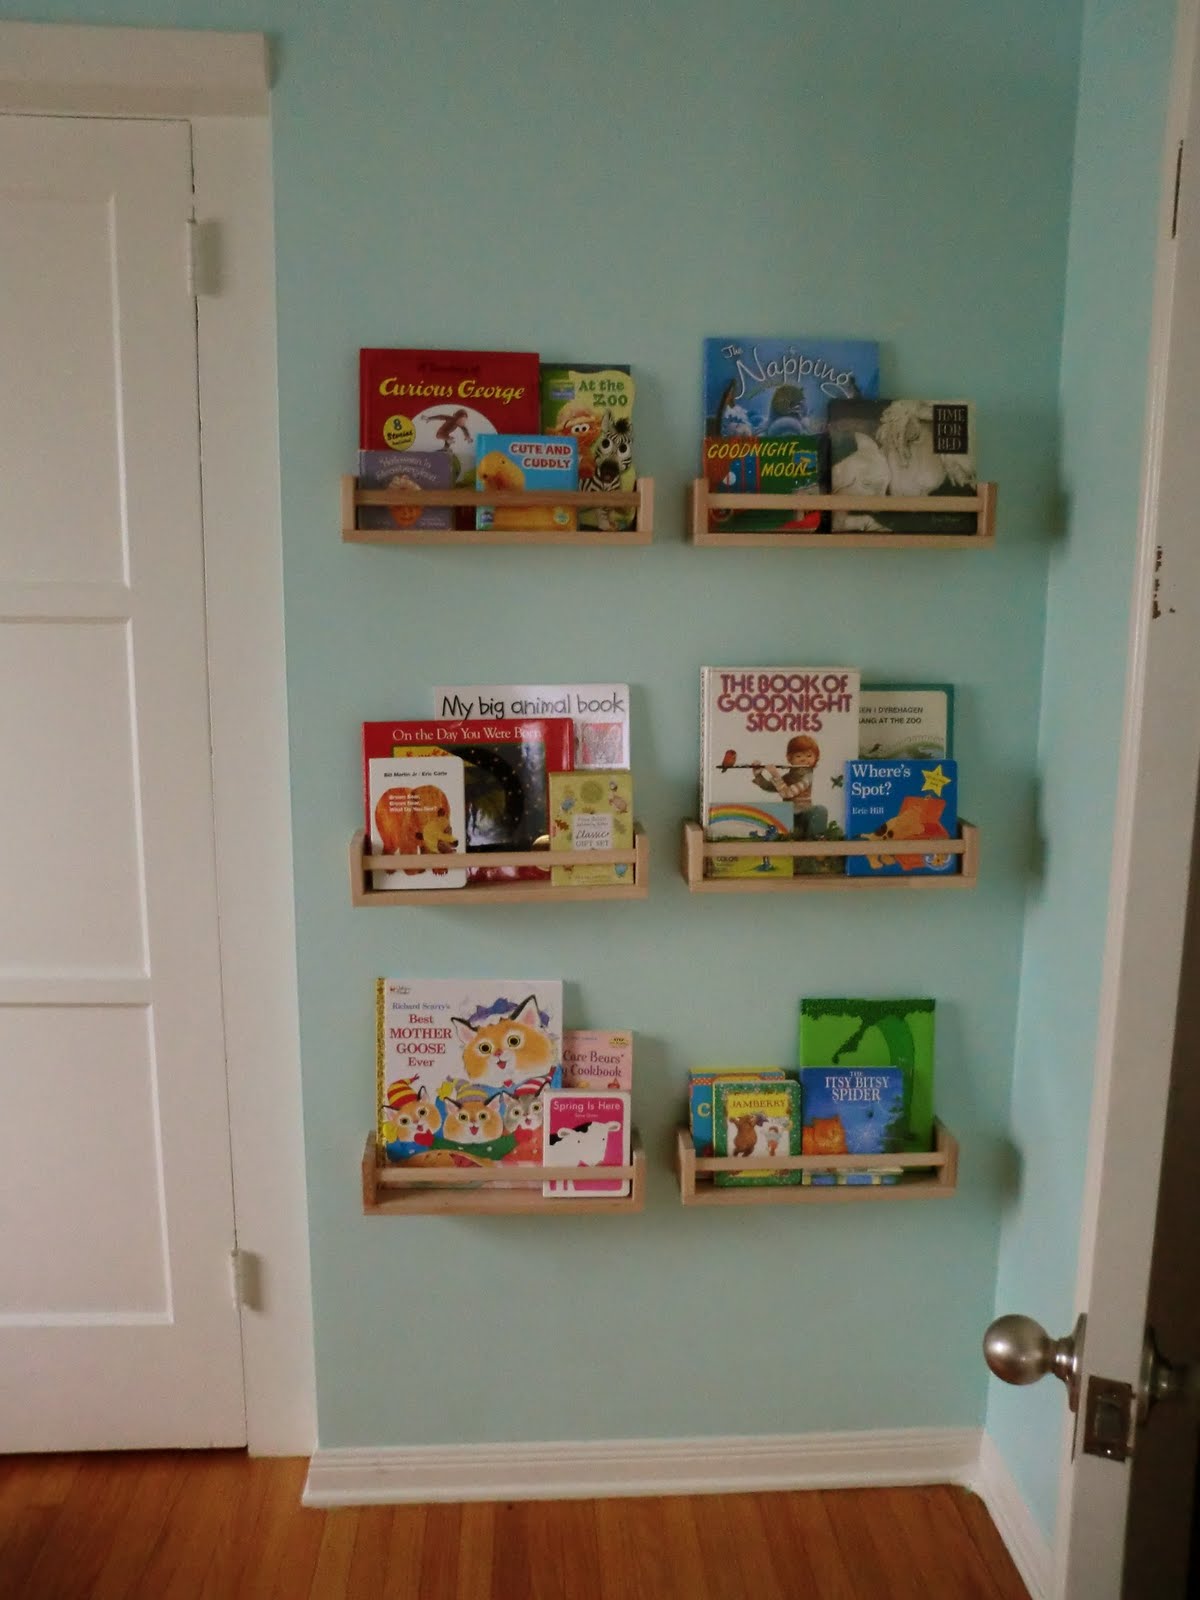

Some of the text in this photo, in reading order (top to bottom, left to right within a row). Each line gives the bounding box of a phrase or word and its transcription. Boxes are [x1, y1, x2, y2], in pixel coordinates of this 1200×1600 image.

[721, 345, 741, 358] The
[734, 348, 854, 399] Napping
[379, 377, 525, 405] Curious George
[579, 379, 624, 391] At the
[936, 408, 965, 421] TIME
[393, 419, 402, 431] 8
[937, 423, 961, 436] FOR
[510, 444, 571, 455] CUTE AND
[707, 442, 799, 459] GOODNIGHT
[523, 458, 571, 468] CUDDLY
[761, 461, 810, 477] MOON
[720, 674, 848, 693] THE BOOK OF
[442, 692, 625, 720] My big animal book
[717, 693, 852, 713] GOODNIGHT
[746, 713, 822, 732] STORIES
[392, 729, 412, 741] On
[415, 728, 433, 741] the
[437, 728, 458, 743] Day
[460, 728, 481, 740] You
[483, 727, 511, 739] Were
[852, 764, 911, 777] Where's
[851, 782, 892, 798] Spot?
[576, 829, 609, 840] Classic
[392, 1002, 450, 1011] Richard Scarry's
[409, 1014, 433, 1023] Best
[390, 1028, 452, 1039] MOTHER
[396, 1043, 446, 1054] GOOSE
[408, 1057, 434, 1067] Ever
[563, 1050, 587, 1062] Care
[571, 1064, 622, 1077] Cookbook
[825, 1076, 890, 1089] ITSY BITSY
[832, 1088, 881, 1100] SPIDER
[553, 1101, 620, 1112] Spring Is Here
[733, 1100, 785, 1108] JAMBERRY
